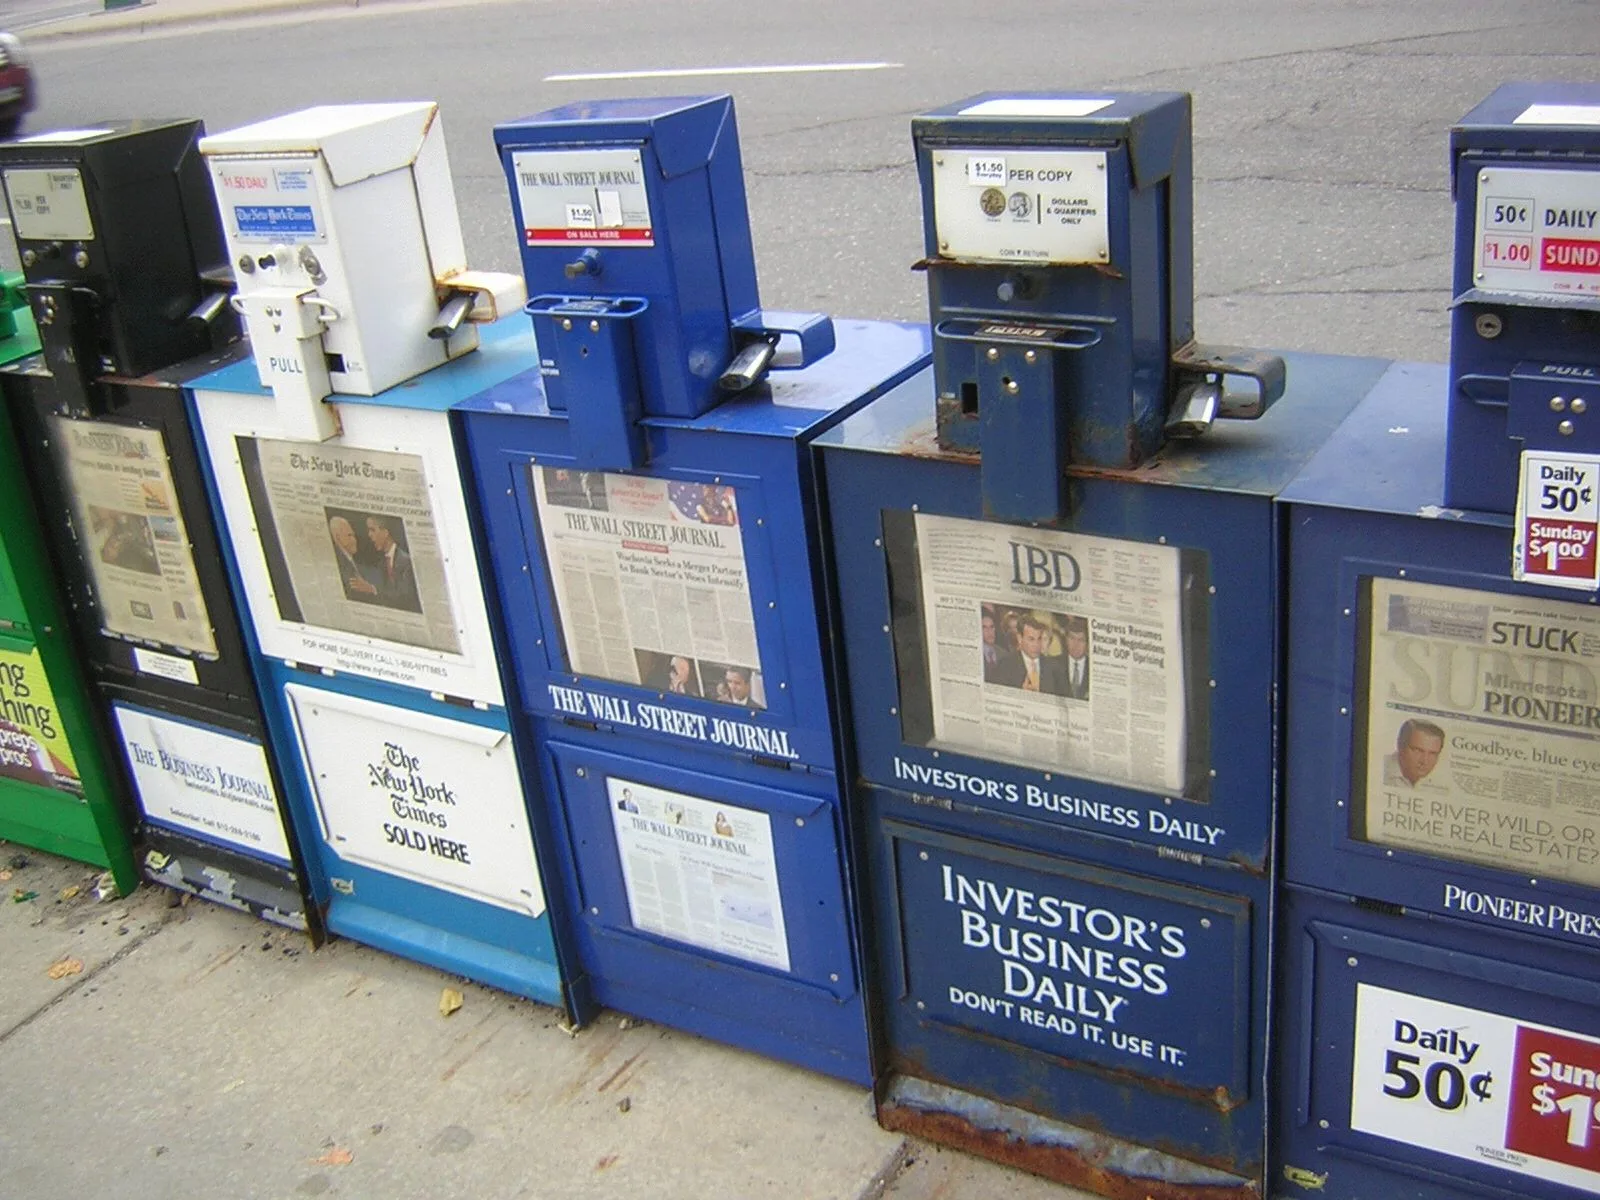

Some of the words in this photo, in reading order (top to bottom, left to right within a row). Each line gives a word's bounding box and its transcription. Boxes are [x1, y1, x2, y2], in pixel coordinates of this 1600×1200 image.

[521, 172, 538, 187] THE
[539, 172, 564, 187] WALL
[564, 172, 598, 187] STREET
[974, 162, 1004, 172] $1.50
[1009, 169, 1035, 182] PER
[1037, 169, 1074, 182] COPY
[570, 208, 593, 217] $1.50
[1053, 208, 1097, 216] QUARTERS
[1061, 217, 1082, 225] ONLY
[1494, 205, 1527, 223] 50¢
[1545, 208, 1598, 229] DAILY
[566, 231, 579, 239] ON
[580, 231, 598, 239] SALE
[600, 231, 620, 239] HERE
[1486, 242, 1530, 262] $1.00
[1546, 244, 1600, 267] SUND
[269, 356, 303, 374] PULL
[1541, 364, 1595, 377] PULL
[290, 453, 309, 471] The
[311, 456, 334, 473] New
[334, 460, 362, 478] York
[362, 462, 396, 481] Times
[1540, 465, 1586, 486] Daily
[1540, 485, 1592, 513] 50¢
[564, 512, 591, 532] THE
[590, 516, 623, 537] WALL
[623, 519, 670, 542] STREET
[1530, 522, 1594, 545] Sunday
[1008, 541, 1082, 592] IBD
[1091, 618, 1127, 634] Congress
[1128, 624, 1163, 641] Resumes
[1490, 621, 1580, 654] STUCK
[374, 653, 393, 666] CALL
[1113, 647, 1131, 659] GOP
[1484, 672, 1589, 700] Minnesota
[0, 687, 57, 739] hing
[547, 683, 588, 716] THE
[587, 692, 638, 727] WALL
[637, 702, 708, 741] STREET
[1483, 690, 1600, 730] PIONEER
[384, 741, 420, 772] The
[1450, 735, 1528, 762] Goodbye,
[1532, 747, 1569, 767] blue
[129, 742, 158, 769] THE
[157, 749, 216, 785] BUSINESS
[217, 765, 273, 802] JOURNAL
[367, 761, 408, 792] New
[408, 774, 456, 807] York
[893, 756, 1020, 803] INVESTOR'S
[1026, 784, 1141, 830] BUSINESS
[390, 793, 448, 829] Times
[1383, 792, 1425, 815] THE
[1430, 801, 1491, 826] RIVER
[1496, 813, 1555, 839] WILD,
[1561, 825, 1597, 845] OR
[383, 822, 427, 852] SOLD
[428, 834, 471, 865] HERE
[1382, 811, 1444, 837] PRIME
[1450, 823, 1504, 850] REAL
[1509, 834, 1599, 865] ESTATE?
[941, 864, 1187, 959] INVESTOR'S
[1443, 883, 1545, 928] PIONEER
[960, 908, 1169, 996] BUSINESS
[1002, 959, 1128, 1024] DAILY
[949, 986, 1015, 1019] DON'T
[1019, 1006, 1077, 1036] READ
[1083, 1022, 1107, 1046] IT.
[1111, 1031, 1154, 1059] USE
[1160, 1044, 1185, 1067] IT.
[1394, 1019, 1480, 1066] Daily
[1382, 1048, 1494, 1112] 50¢
[1529, 1051, 1600, 1091] Sun
[1531, 1082, 1600, 1148] $1
